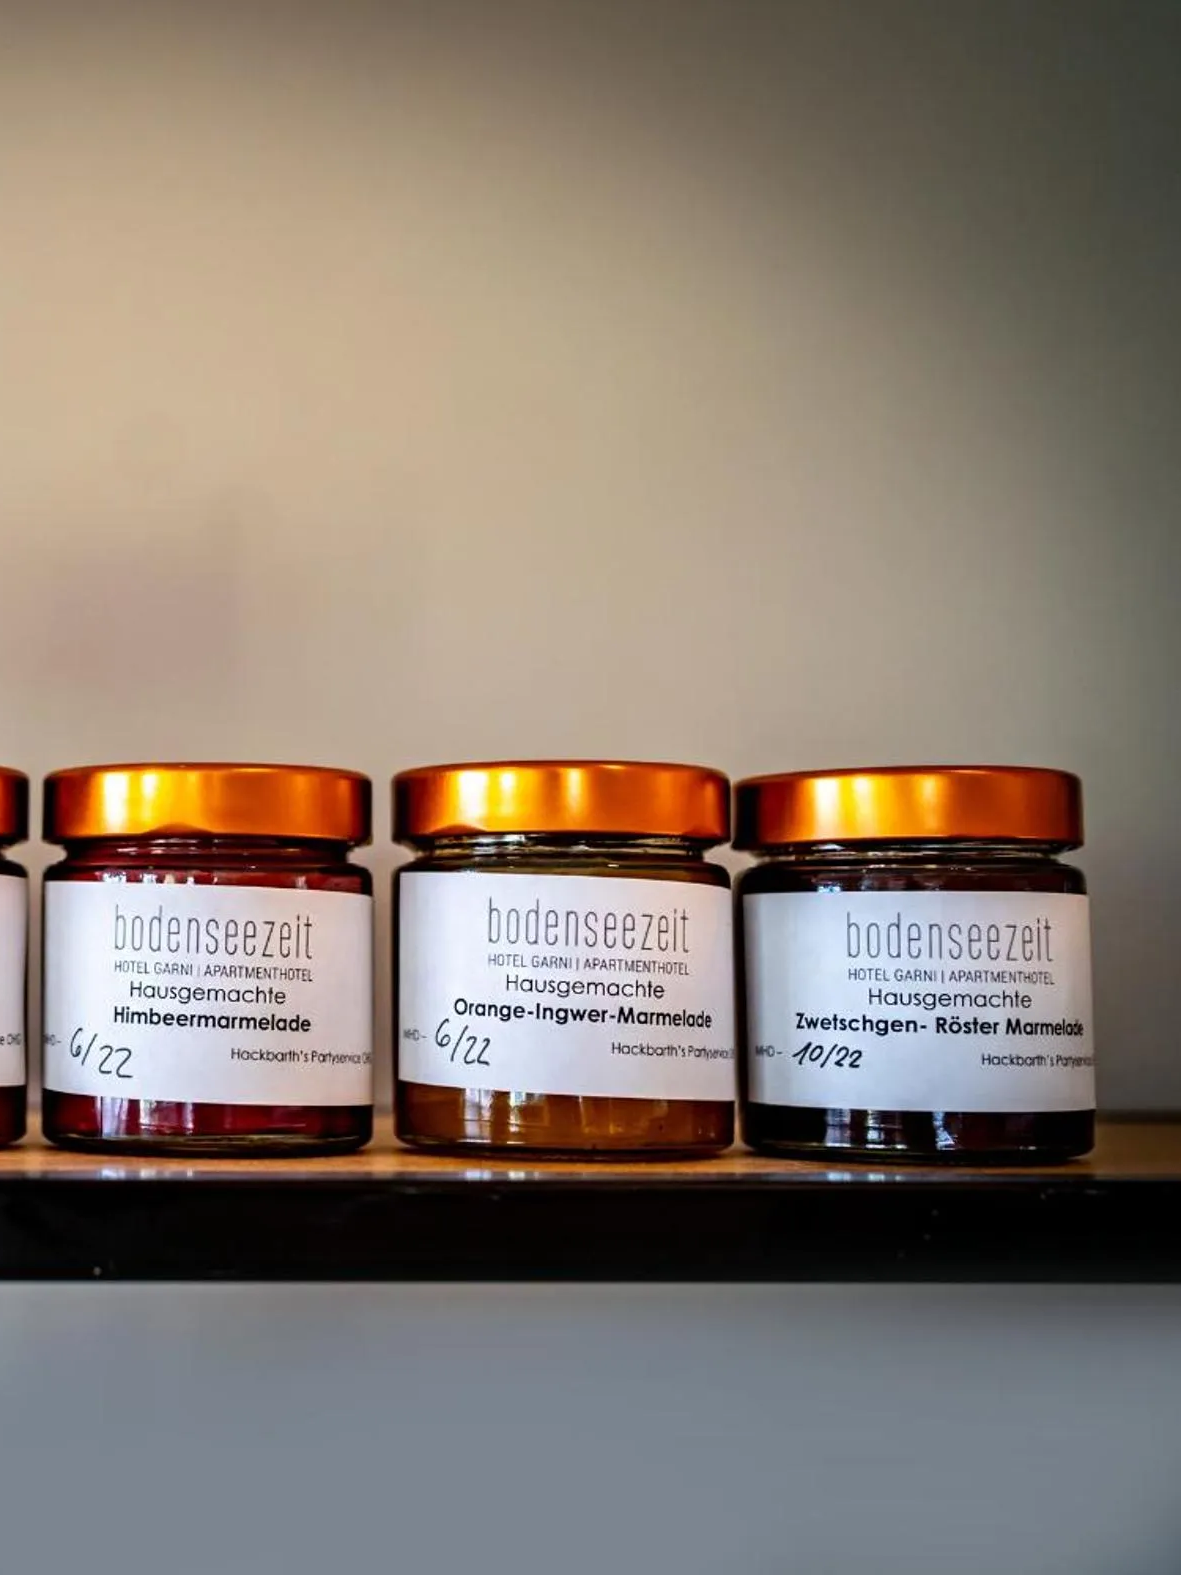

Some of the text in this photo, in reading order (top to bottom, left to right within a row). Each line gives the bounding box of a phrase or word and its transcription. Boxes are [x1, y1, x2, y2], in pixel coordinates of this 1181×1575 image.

[114, 904, 313, 959] bodenseezeit
[488, 896, 689, 953] bodenseezeit
[847, 911, 1053, 962] bodenseezeit
[114, 961, 150, 975] HOTEL
[154, 962, 193, 976] GARNI
[204, 965, 313, 982] APARTMENTHOTEL
[488, 954, 527, 968] HOTEL
[531, 955, 572, 970] GARNI
[584, 958, 690, 976] APARTMENTHOTEL
[848, 968, 890, 981] HOTEL
[894, 969, 936, 982] GARNI
[949, 970, 1055, 985] APARTMENTHOTEL
[129, 981, 286, 1004] Hausgemachte
[506, 974, 665, 999] Hausgemachte
[868, 988, 1032, 1010] Hausgemachte
[114, 1006, 312, 1032] Himbeermarmelade
[454, 998, 712, 1029] Orange-Ingwer-Marmelade
[796, 1012, 1083, 1037] Zwetschgen- Röster Marmelade
[69, 1027, 134, 1079] 6/22
[435, 1018, 491, 1066] 6/22
[611, 1041, 686, 1058] Hackbarth's
[231, 1047, 309, 1063] Hackbarth's
[792, 1041, 862, 1069] 10/22
[981, 1052, 1055, 1067] Hackbarth's
